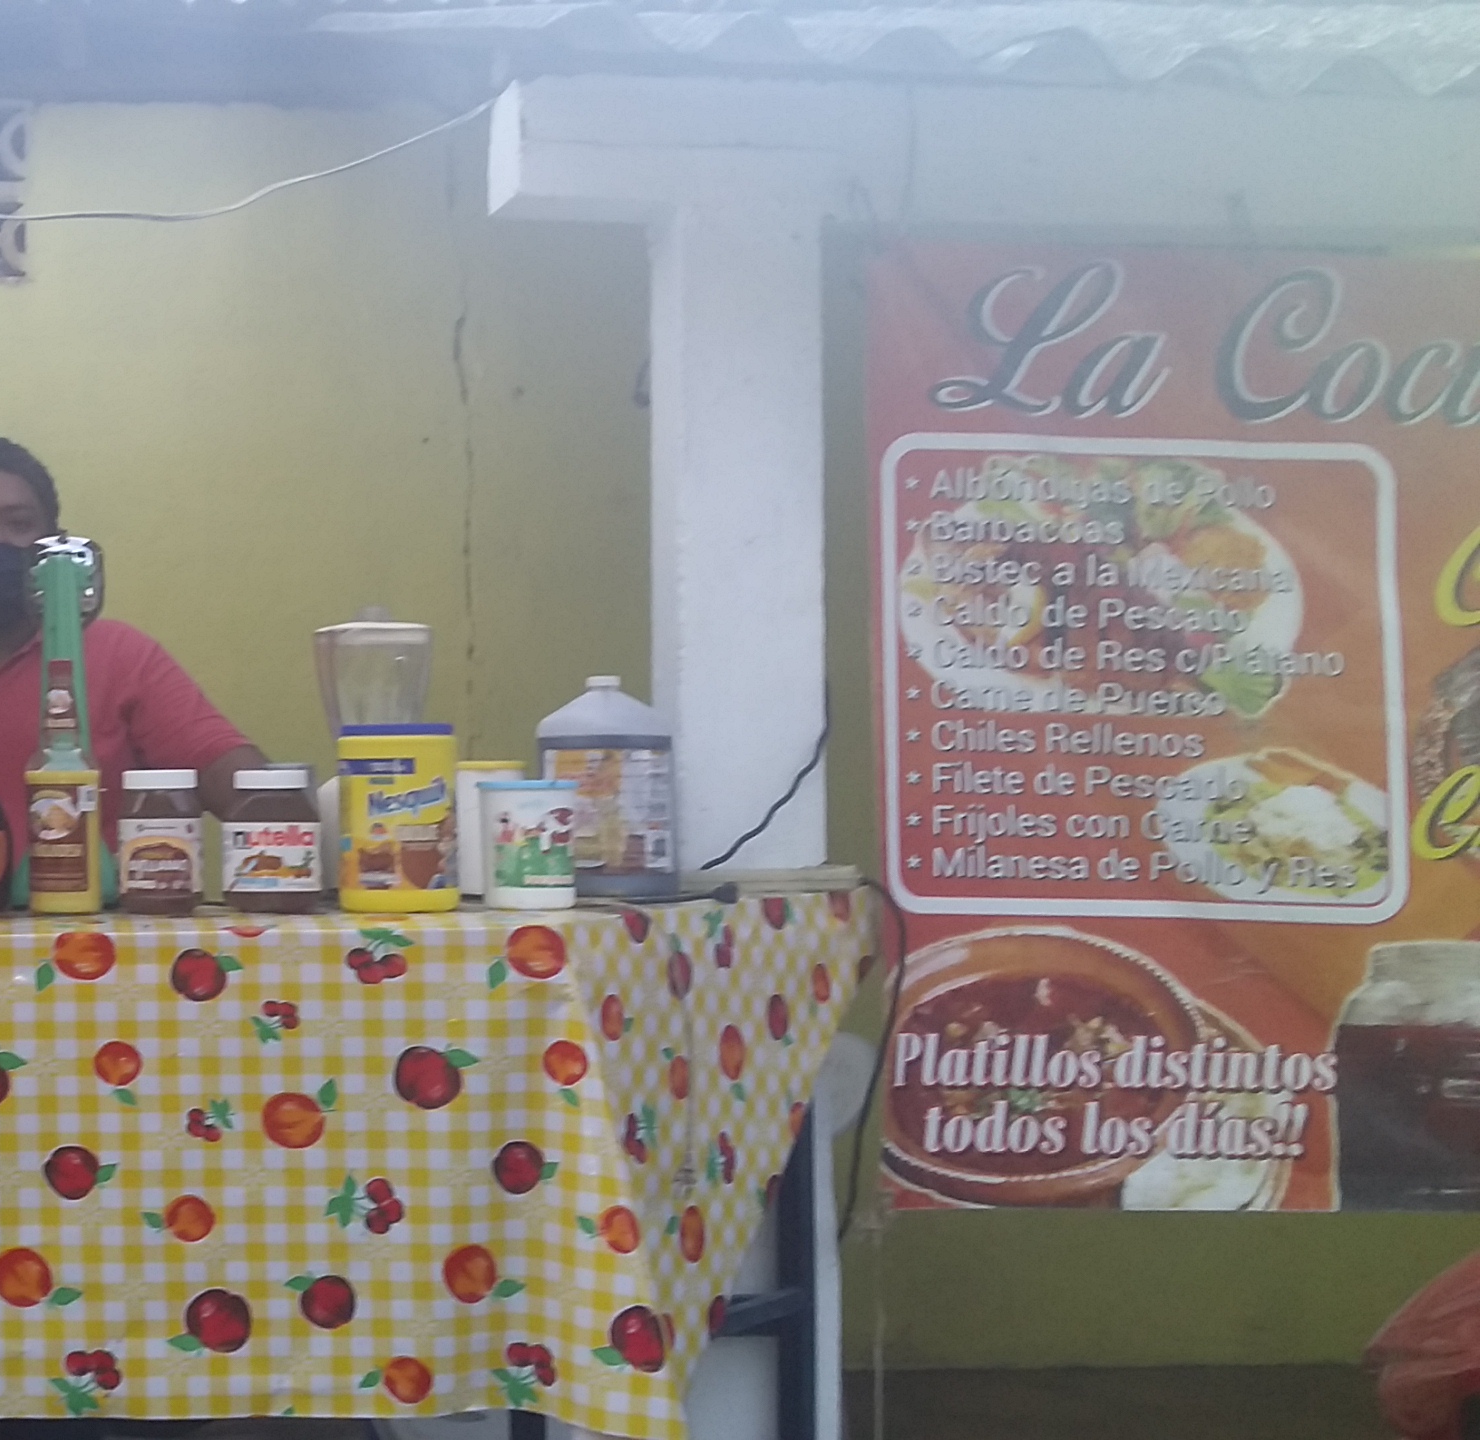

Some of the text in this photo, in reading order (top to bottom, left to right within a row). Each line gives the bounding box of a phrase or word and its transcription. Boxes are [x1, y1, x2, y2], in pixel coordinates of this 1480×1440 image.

[932, 258, 1170, 419] La
[929, 467, 1277, 511] Albóndigas de Pollo
[929, 511, 1126, 545] Barbacoas
[932, 552, 1296, 594] Bistec a la Mexicana
[932, 594, 1250, 634] Caldo de Pescado
[932, 637, 1030, 669] Caldo
[1038, 637, 1087, 670] de
[1097, 640, 1168, 673] Res
[931, 679, 1228, 717] Carne de Puerco
[931, 719, 1206, 758] Chiles Rellenos
[932, 761, 1248, 801] Filete de Pescado
[232, 824, 315, 850] nutella
[932, 803, 1257, 845] Frijoles con Carne
[932, 845, 1358, 896] Milanesa de Pollo y Res
[892, 1032, 1339, 1093] Platillos distintos
[923, 1101, 1308, 1159] todos los días!!
